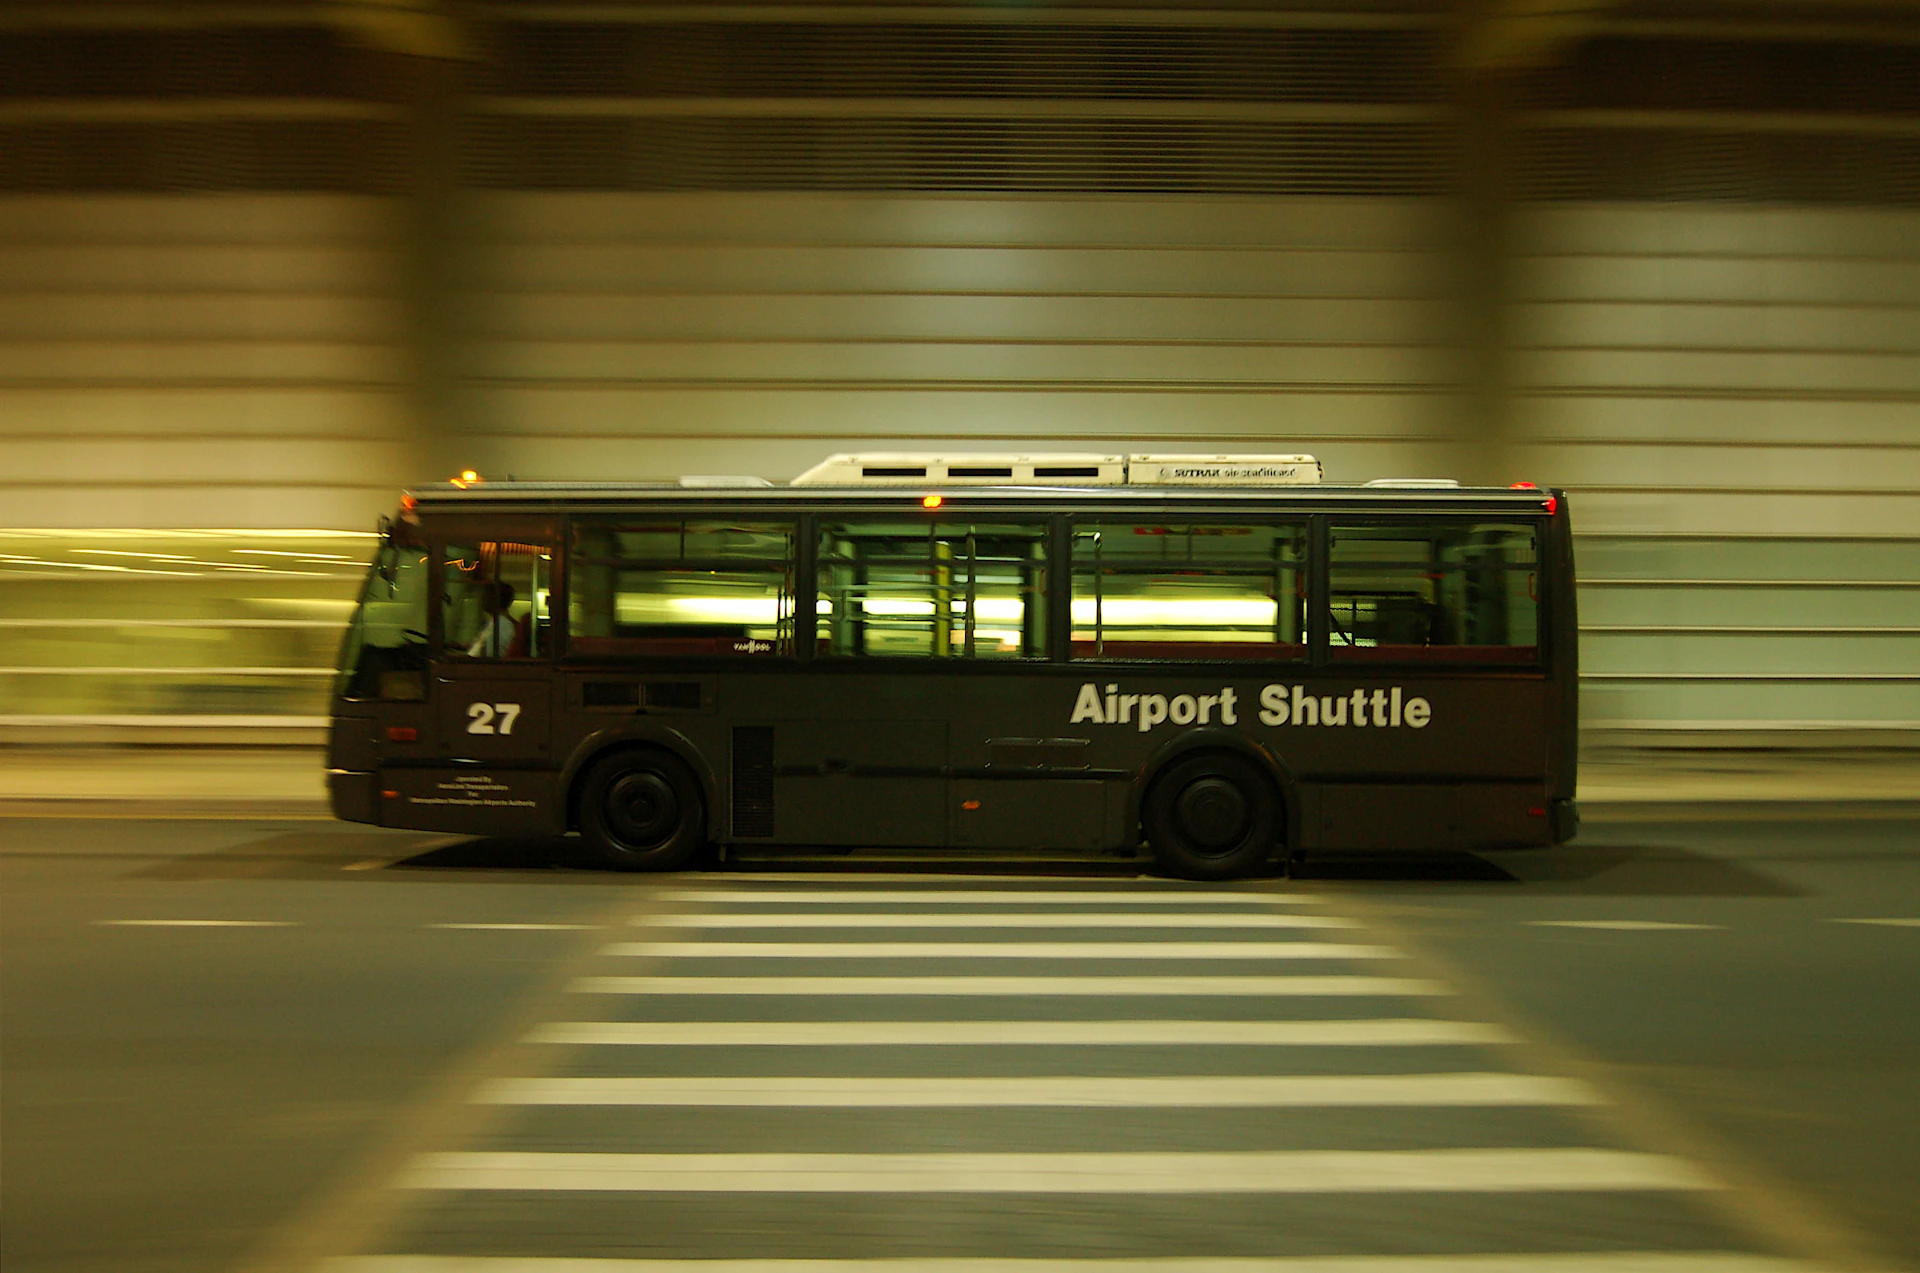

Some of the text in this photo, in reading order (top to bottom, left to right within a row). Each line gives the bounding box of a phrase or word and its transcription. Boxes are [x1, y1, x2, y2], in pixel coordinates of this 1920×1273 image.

[466, 702, 521, 736] 27
[1070, 682, 1432, 732] Airport Shuttle
